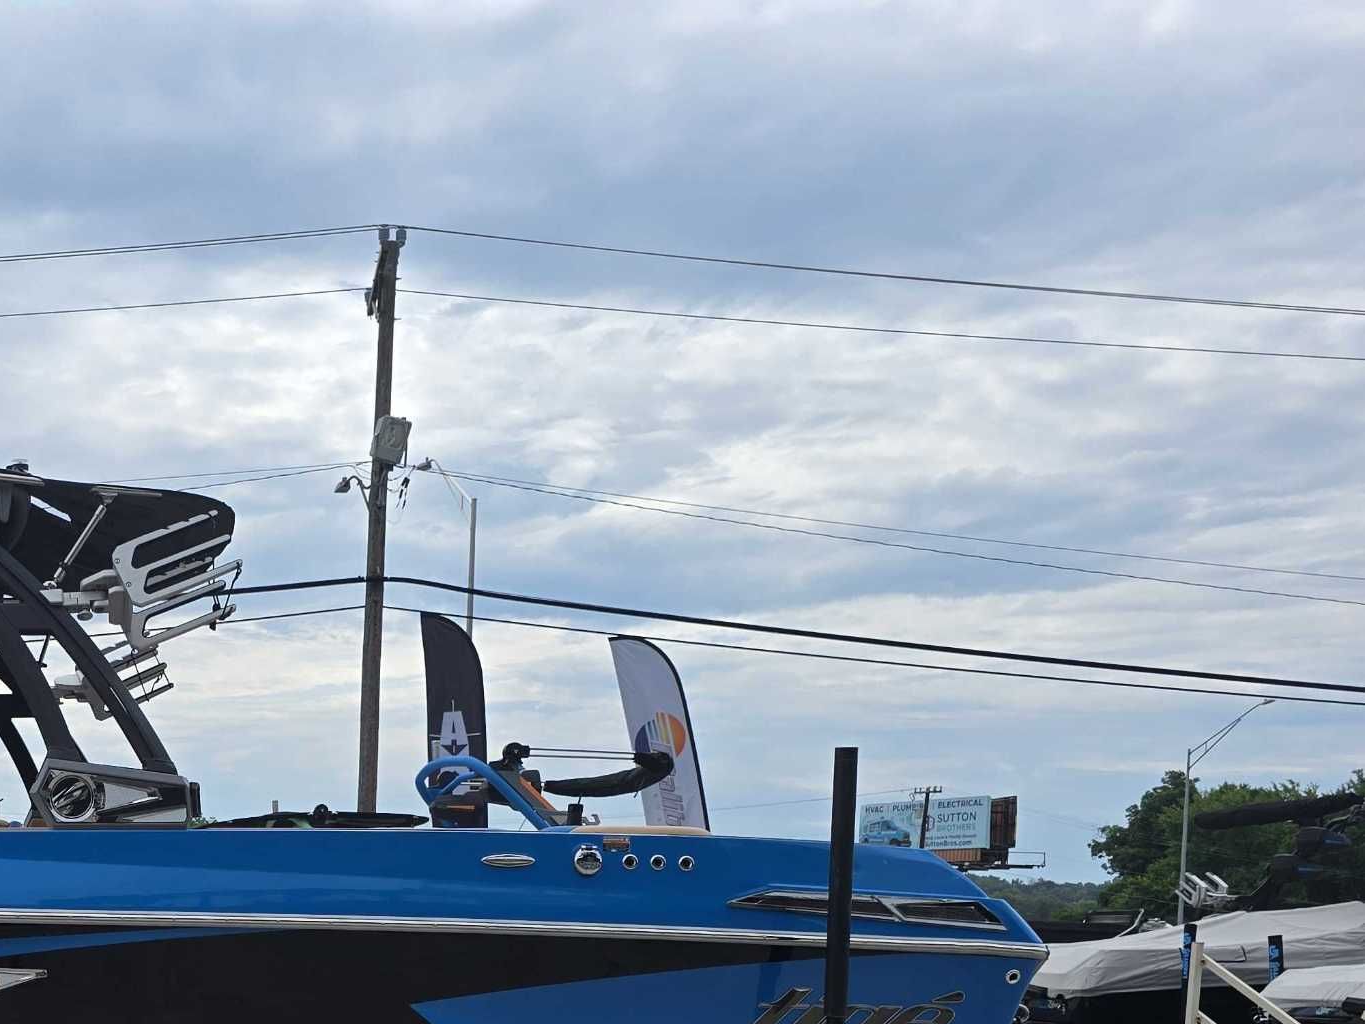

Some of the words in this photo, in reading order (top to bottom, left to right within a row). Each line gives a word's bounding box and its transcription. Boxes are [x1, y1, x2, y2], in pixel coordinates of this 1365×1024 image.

[865, 805, 884, 813] HVAC
[937, 799, 983, 808] ELECTRICAL
[937, 811, 977, 823] SUTTON
